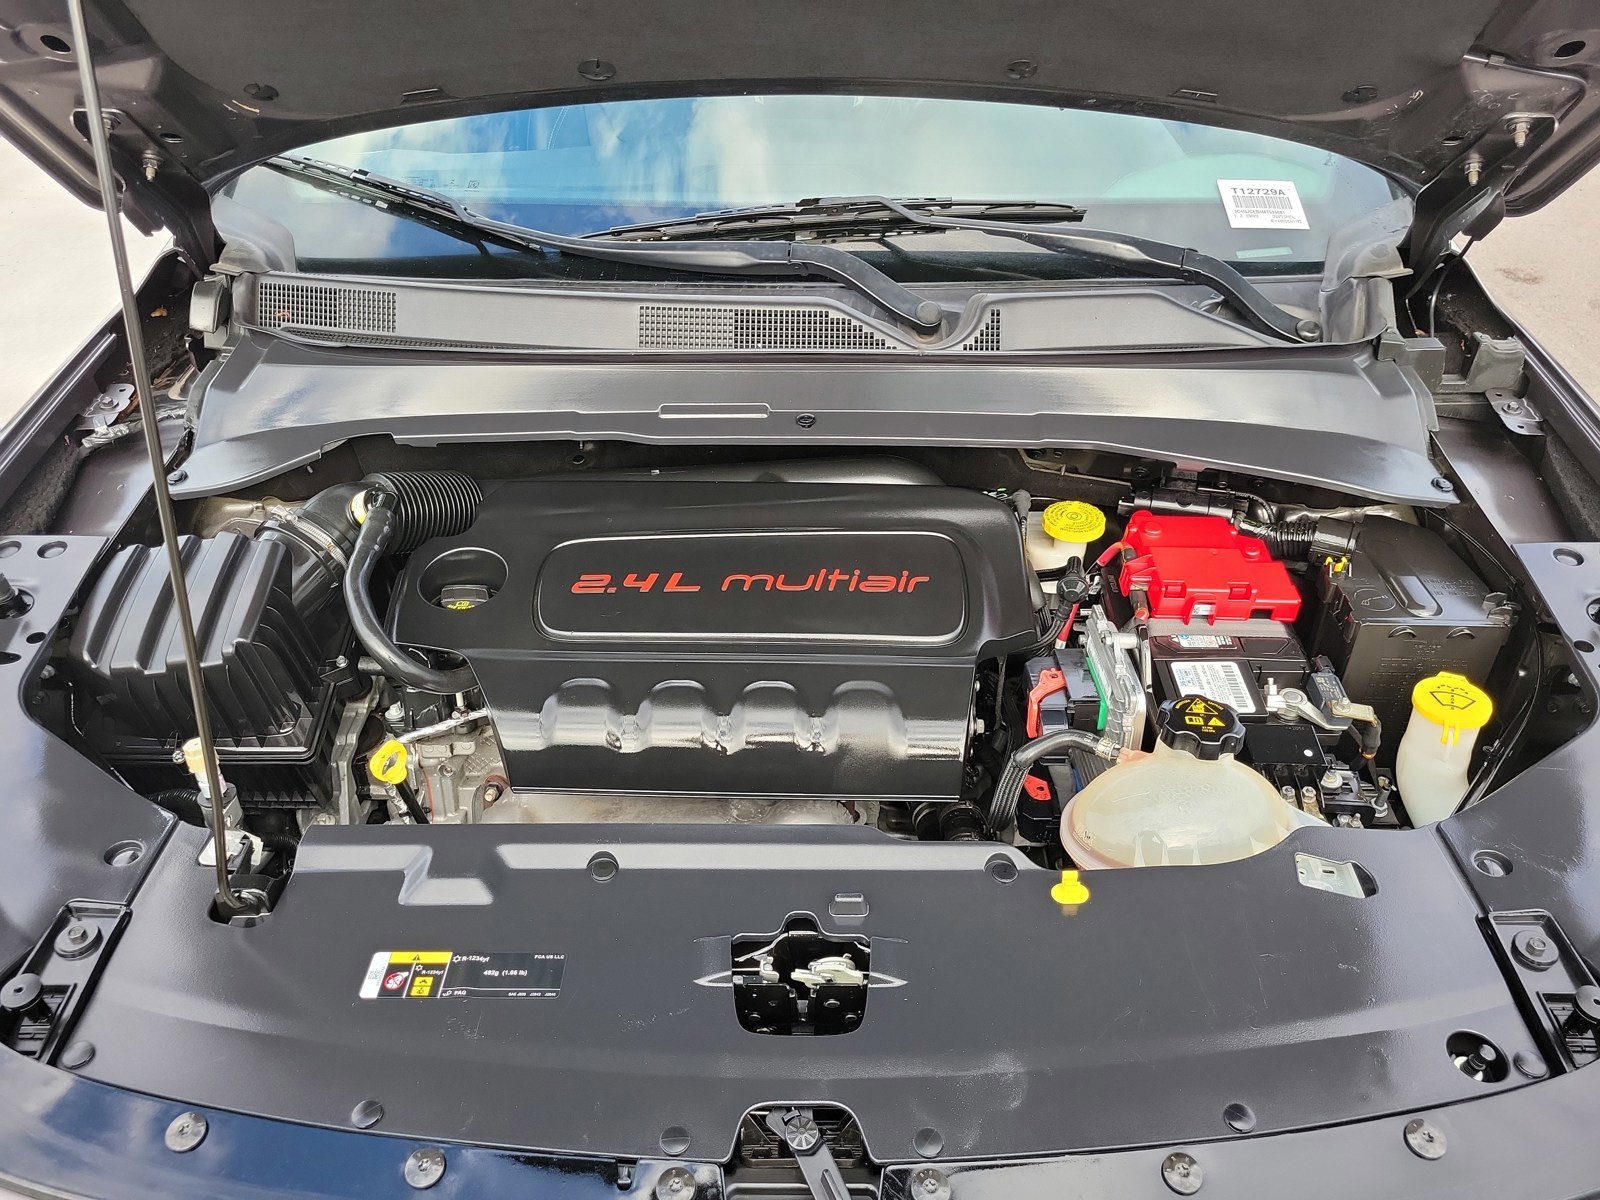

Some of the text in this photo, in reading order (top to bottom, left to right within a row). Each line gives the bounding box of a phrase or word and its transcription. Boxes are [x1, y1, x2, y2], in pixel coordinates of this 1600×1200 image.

[1230, 187, 1286, 196] T12729A
[571, 568, 930, 594] 2.4L multiair
[461, 955, 490, 963] R-1234yf
